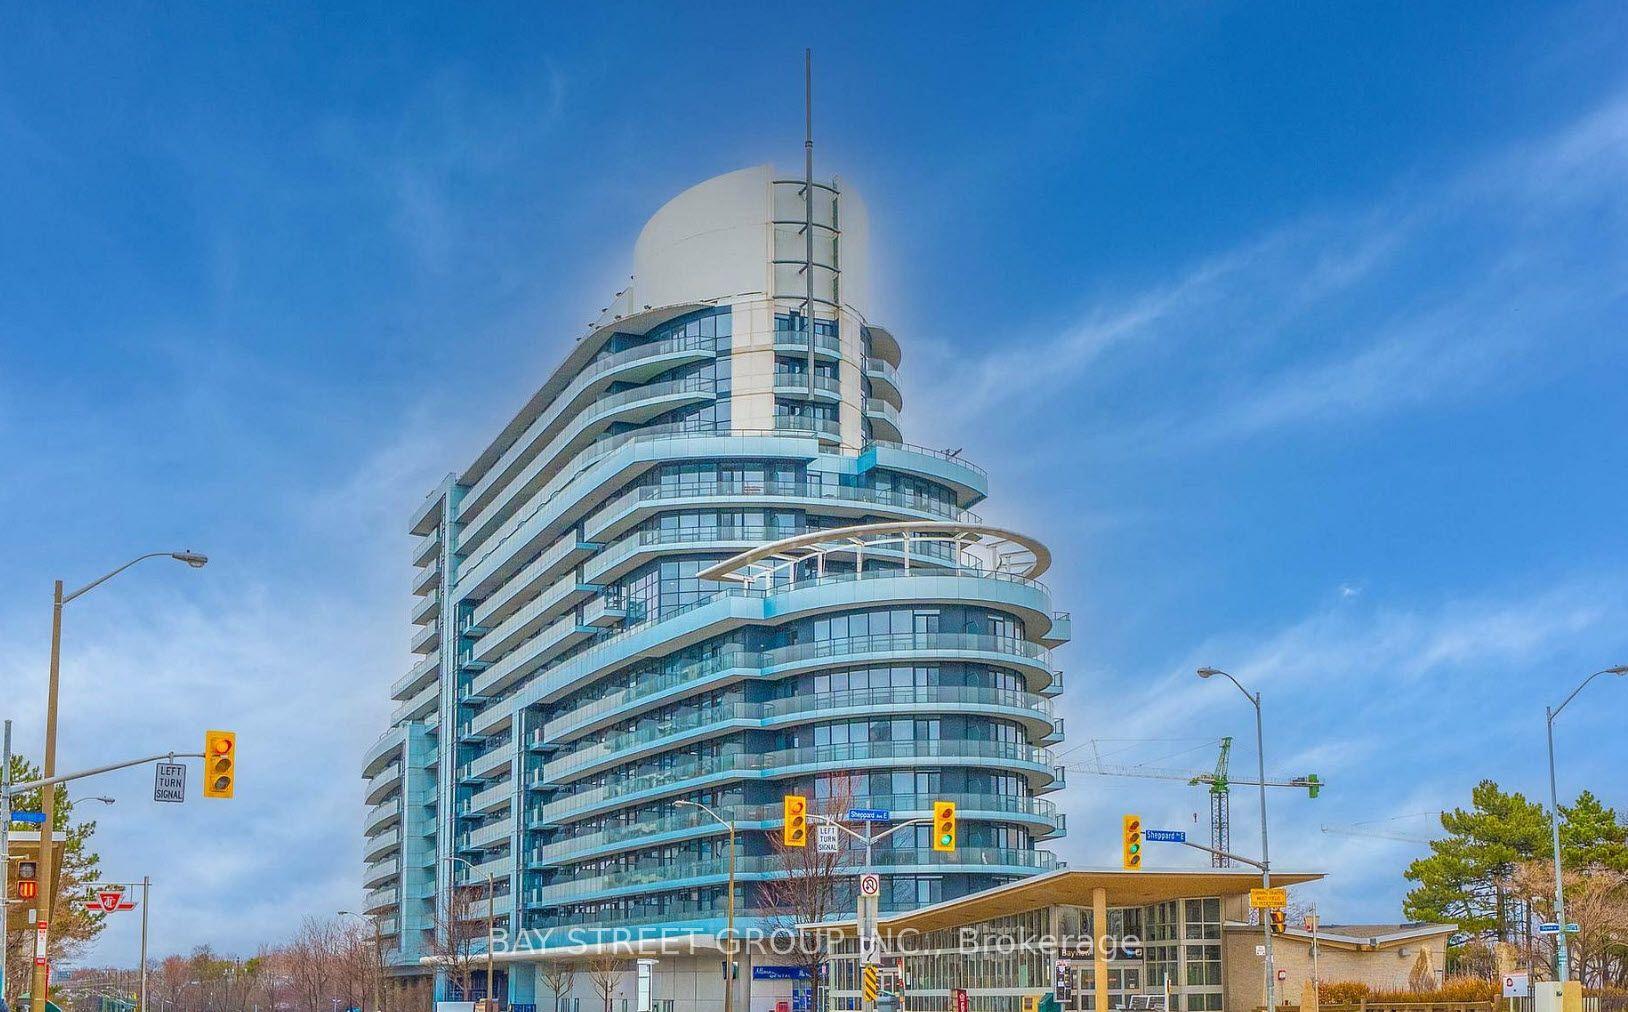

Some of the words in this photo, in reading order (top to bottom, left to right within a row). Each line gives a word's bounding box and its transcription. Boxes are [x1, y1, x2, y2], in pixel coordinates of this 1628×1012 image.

[160, 766, 181, 776] LEFT
[159, 778, 181, 788] TURN
[156, 789, 183, 799] SIGNAL
[850, 810, 875, 819] Sheppard
[820, 827, 835, 835] LEFT
[1147, 831, 1175, 841] Sheppard
